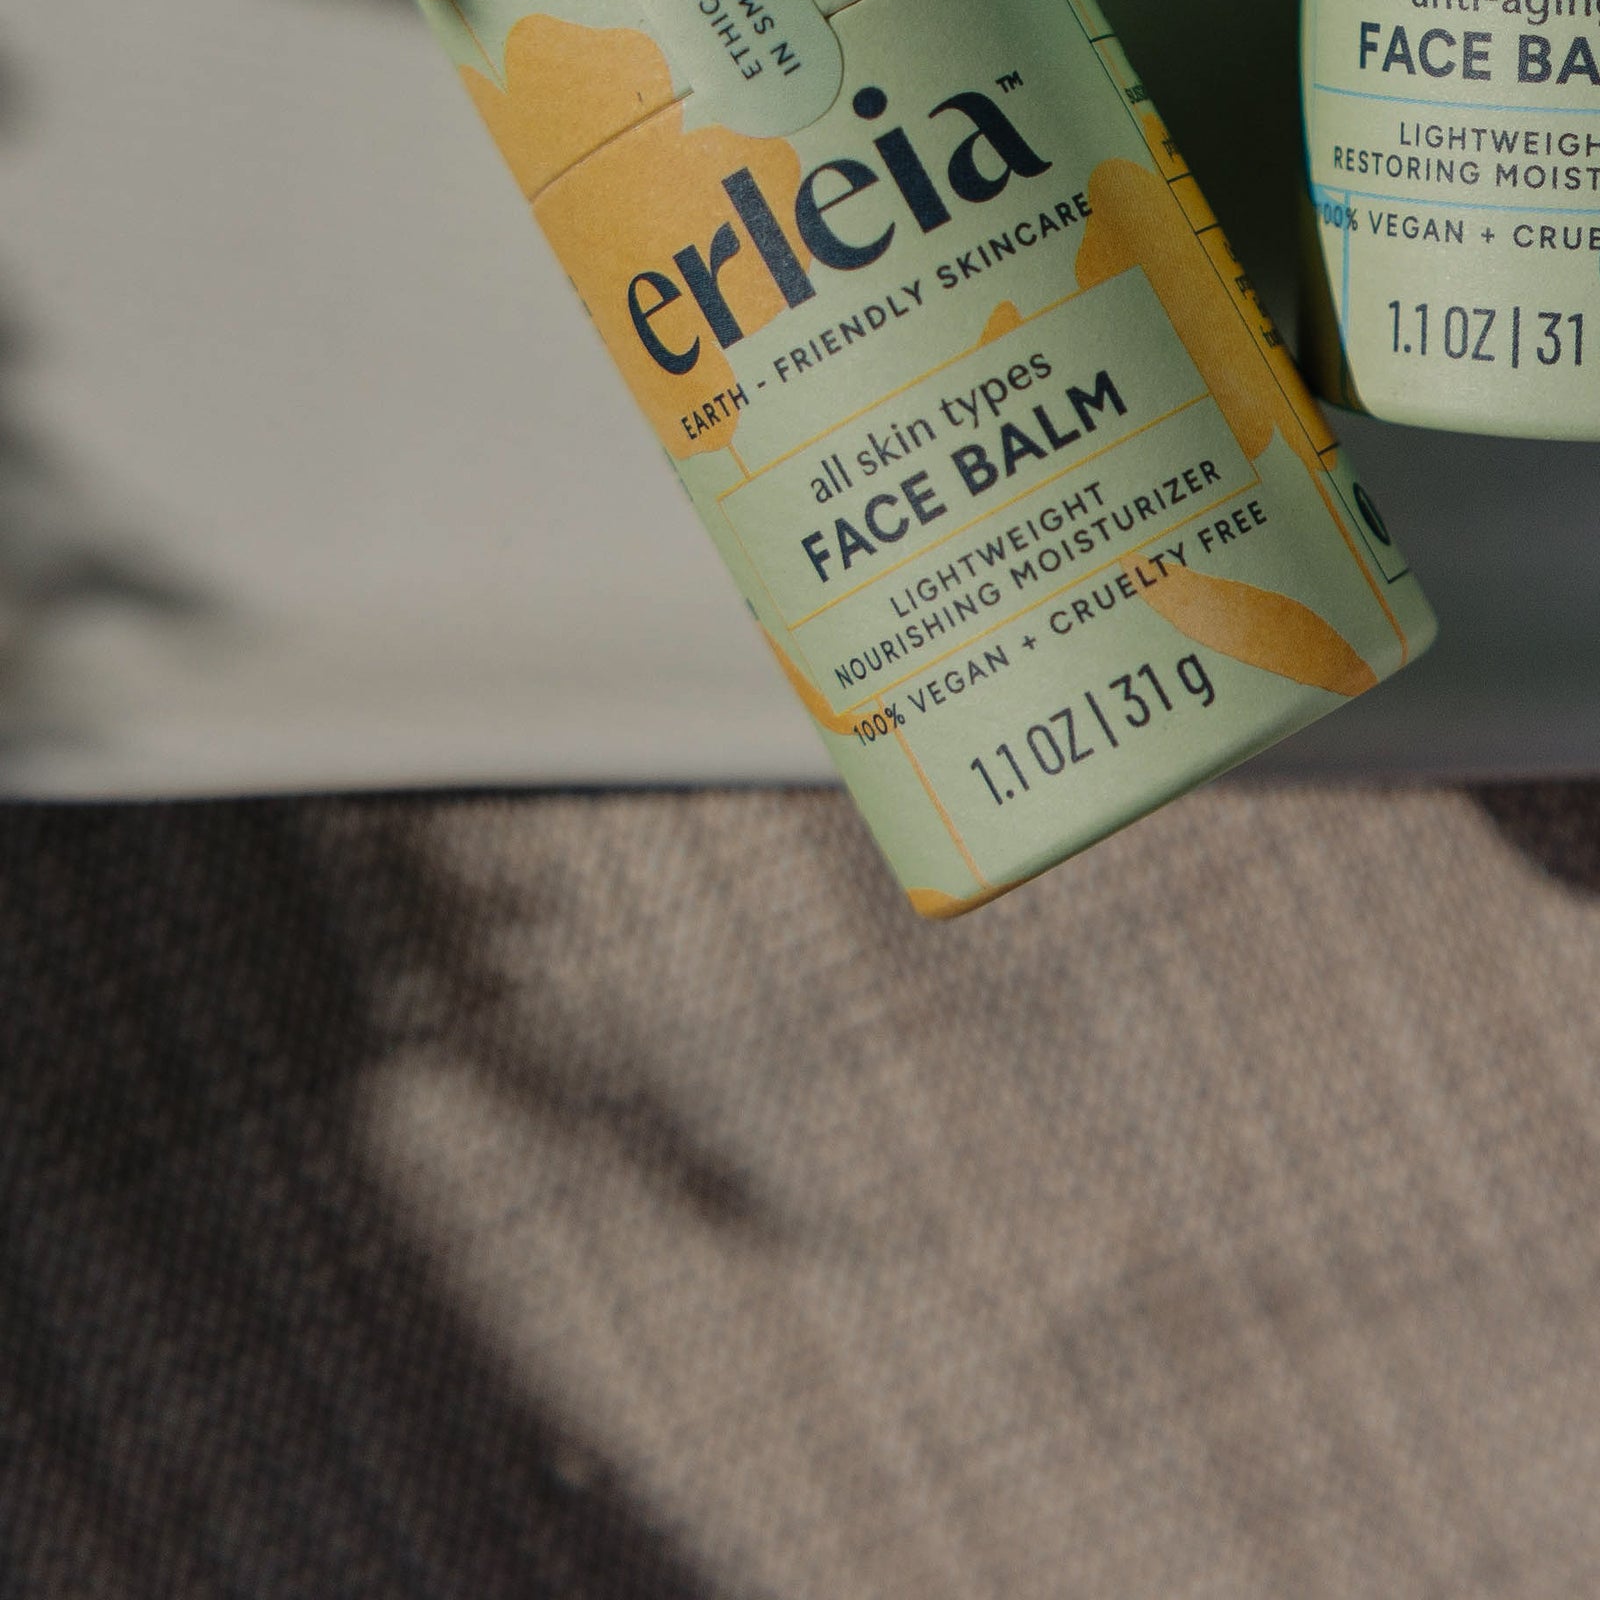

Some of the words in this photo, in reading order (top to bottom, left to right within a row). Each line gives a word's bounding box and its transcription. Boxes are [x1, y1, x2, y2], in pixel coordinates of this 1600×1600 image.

[770, 40, 802, 77] IN
[1360, 21, 1492, 81] FACE
[627, 85, 1053, 376] erleia
[1322, 204, 1358, 231] 00%
[1369, 211, 1463, 243] VEGAN
[1335, 142, 1481, 185] RESTORING
[680, 383, 750, 440] EARTH
[773, 279, 923, 383] FRIENDLY
[936, 191, 1094, 289] SKINCARE
[1389, 301, 1427, 355] 1.1
[1445, 306, 1496, 361] OZ
[1537, 312, 1583, 366] 31
[801, 470, 948, 583] FACE
[950, 369, 1128, 497] BALM
[810, 454, 853, 504] all
[857, 418, 937, 476] skin
[939, 352, 1052, 429] types
[834, 582, 1001, 689] NOURISHING
[1010, 459, 1222, 590] MOISTURIZER
[853, 703, 906, 746] 100%
[907, 645, 1010, 713] VEGAN
[1049, 541, 1188, 635] CRUELTY
[1197, 500, 1268, 553] FREE
[890, 481, 1104, 618] LIGHTWEIGHT
[970, 743, 1030, 806] 1.1
[1026, 707, 1095, 776] OZ
[1109, 663, 1173, 728] 31
[1176, 654, 1215, 708] g
